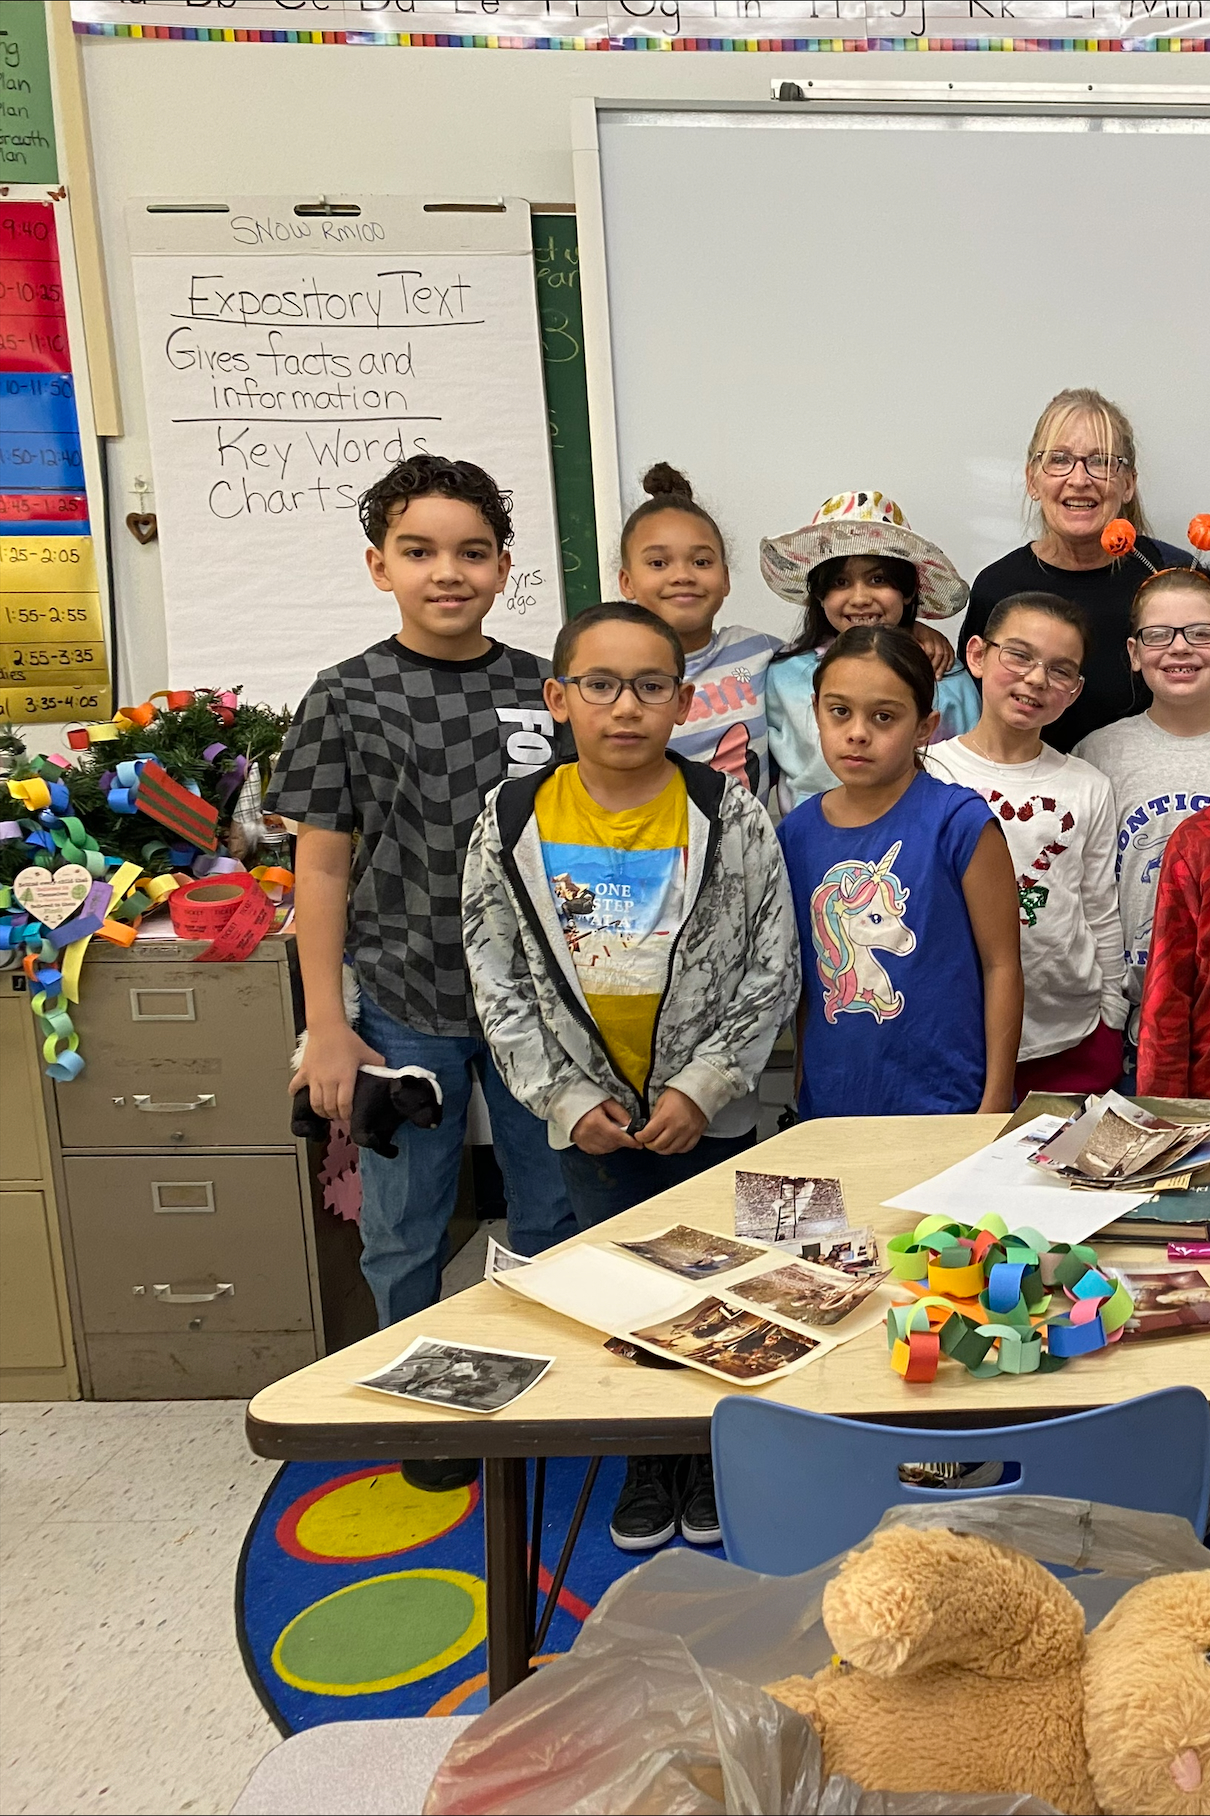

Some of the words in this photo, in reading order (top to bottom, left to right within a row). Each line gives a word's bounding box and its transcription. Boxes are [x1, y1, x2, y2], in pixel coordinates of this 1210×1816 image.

[0, 70, 31, 94] lan
[0, 102, 29, 119] lan
[0, 147, 27, 165] lan
[230, 215, 311, 245] SNOW
[188, 274, 381, 329] Expository
[377, 271, 471, 319] Text
[166, 327, 250, 372] Gives
[256, 330, 352, 380] facts
[359, 342, 416, 378] and
[211, 375, 409, 413] information
[217, 426, 292, 479] Key
[305, 427, 432, 467] Words
[506, 594, 537, 615] ago
[595, 882, 631, 898] ONE
[592, 898, 634, 913] STEP
